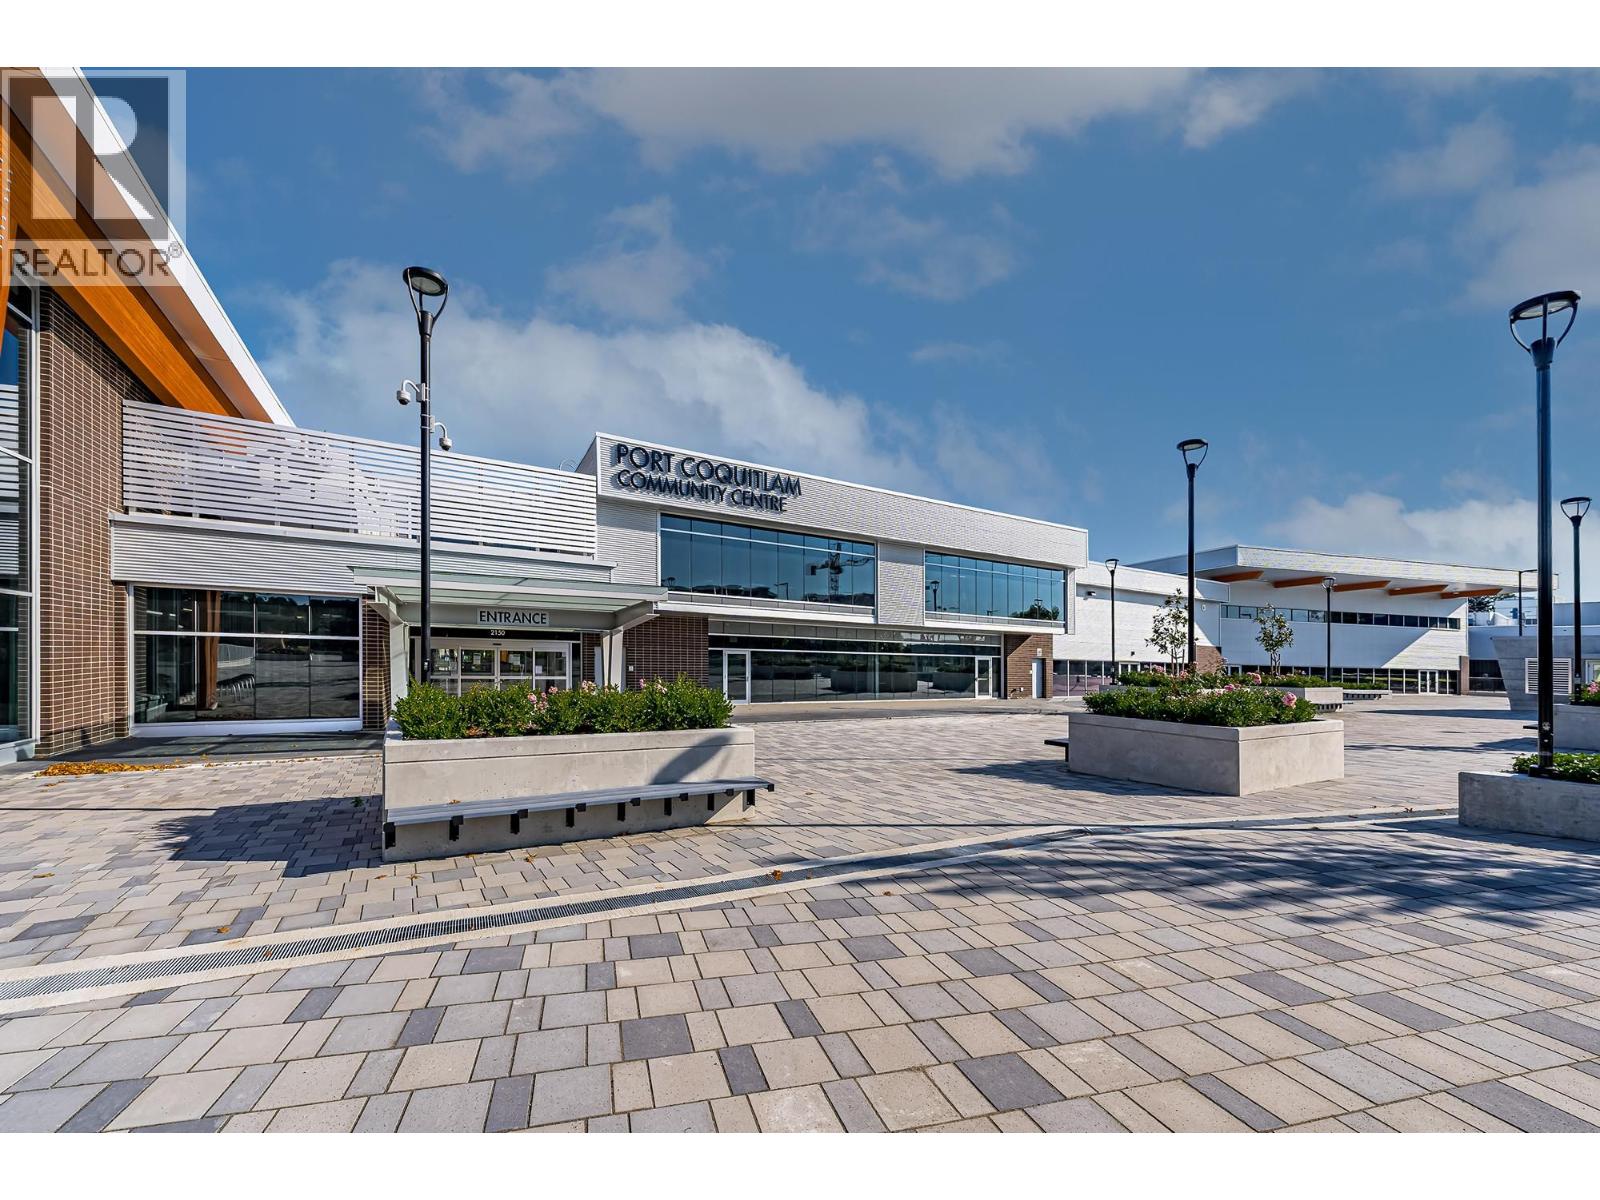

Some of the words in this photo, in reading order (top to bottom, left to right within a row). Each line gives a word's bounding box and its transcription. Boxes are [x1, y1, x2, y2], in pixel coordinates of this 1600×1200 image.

[616, 443, 675, 473] PORT
[680, 457, 802, 496] COQUITLAM
[617, 469, 727, 502] COMMUNITY
[731, 489, 788, 512] CENTRE
[479, 610, 547, 624] ENTRANCE
